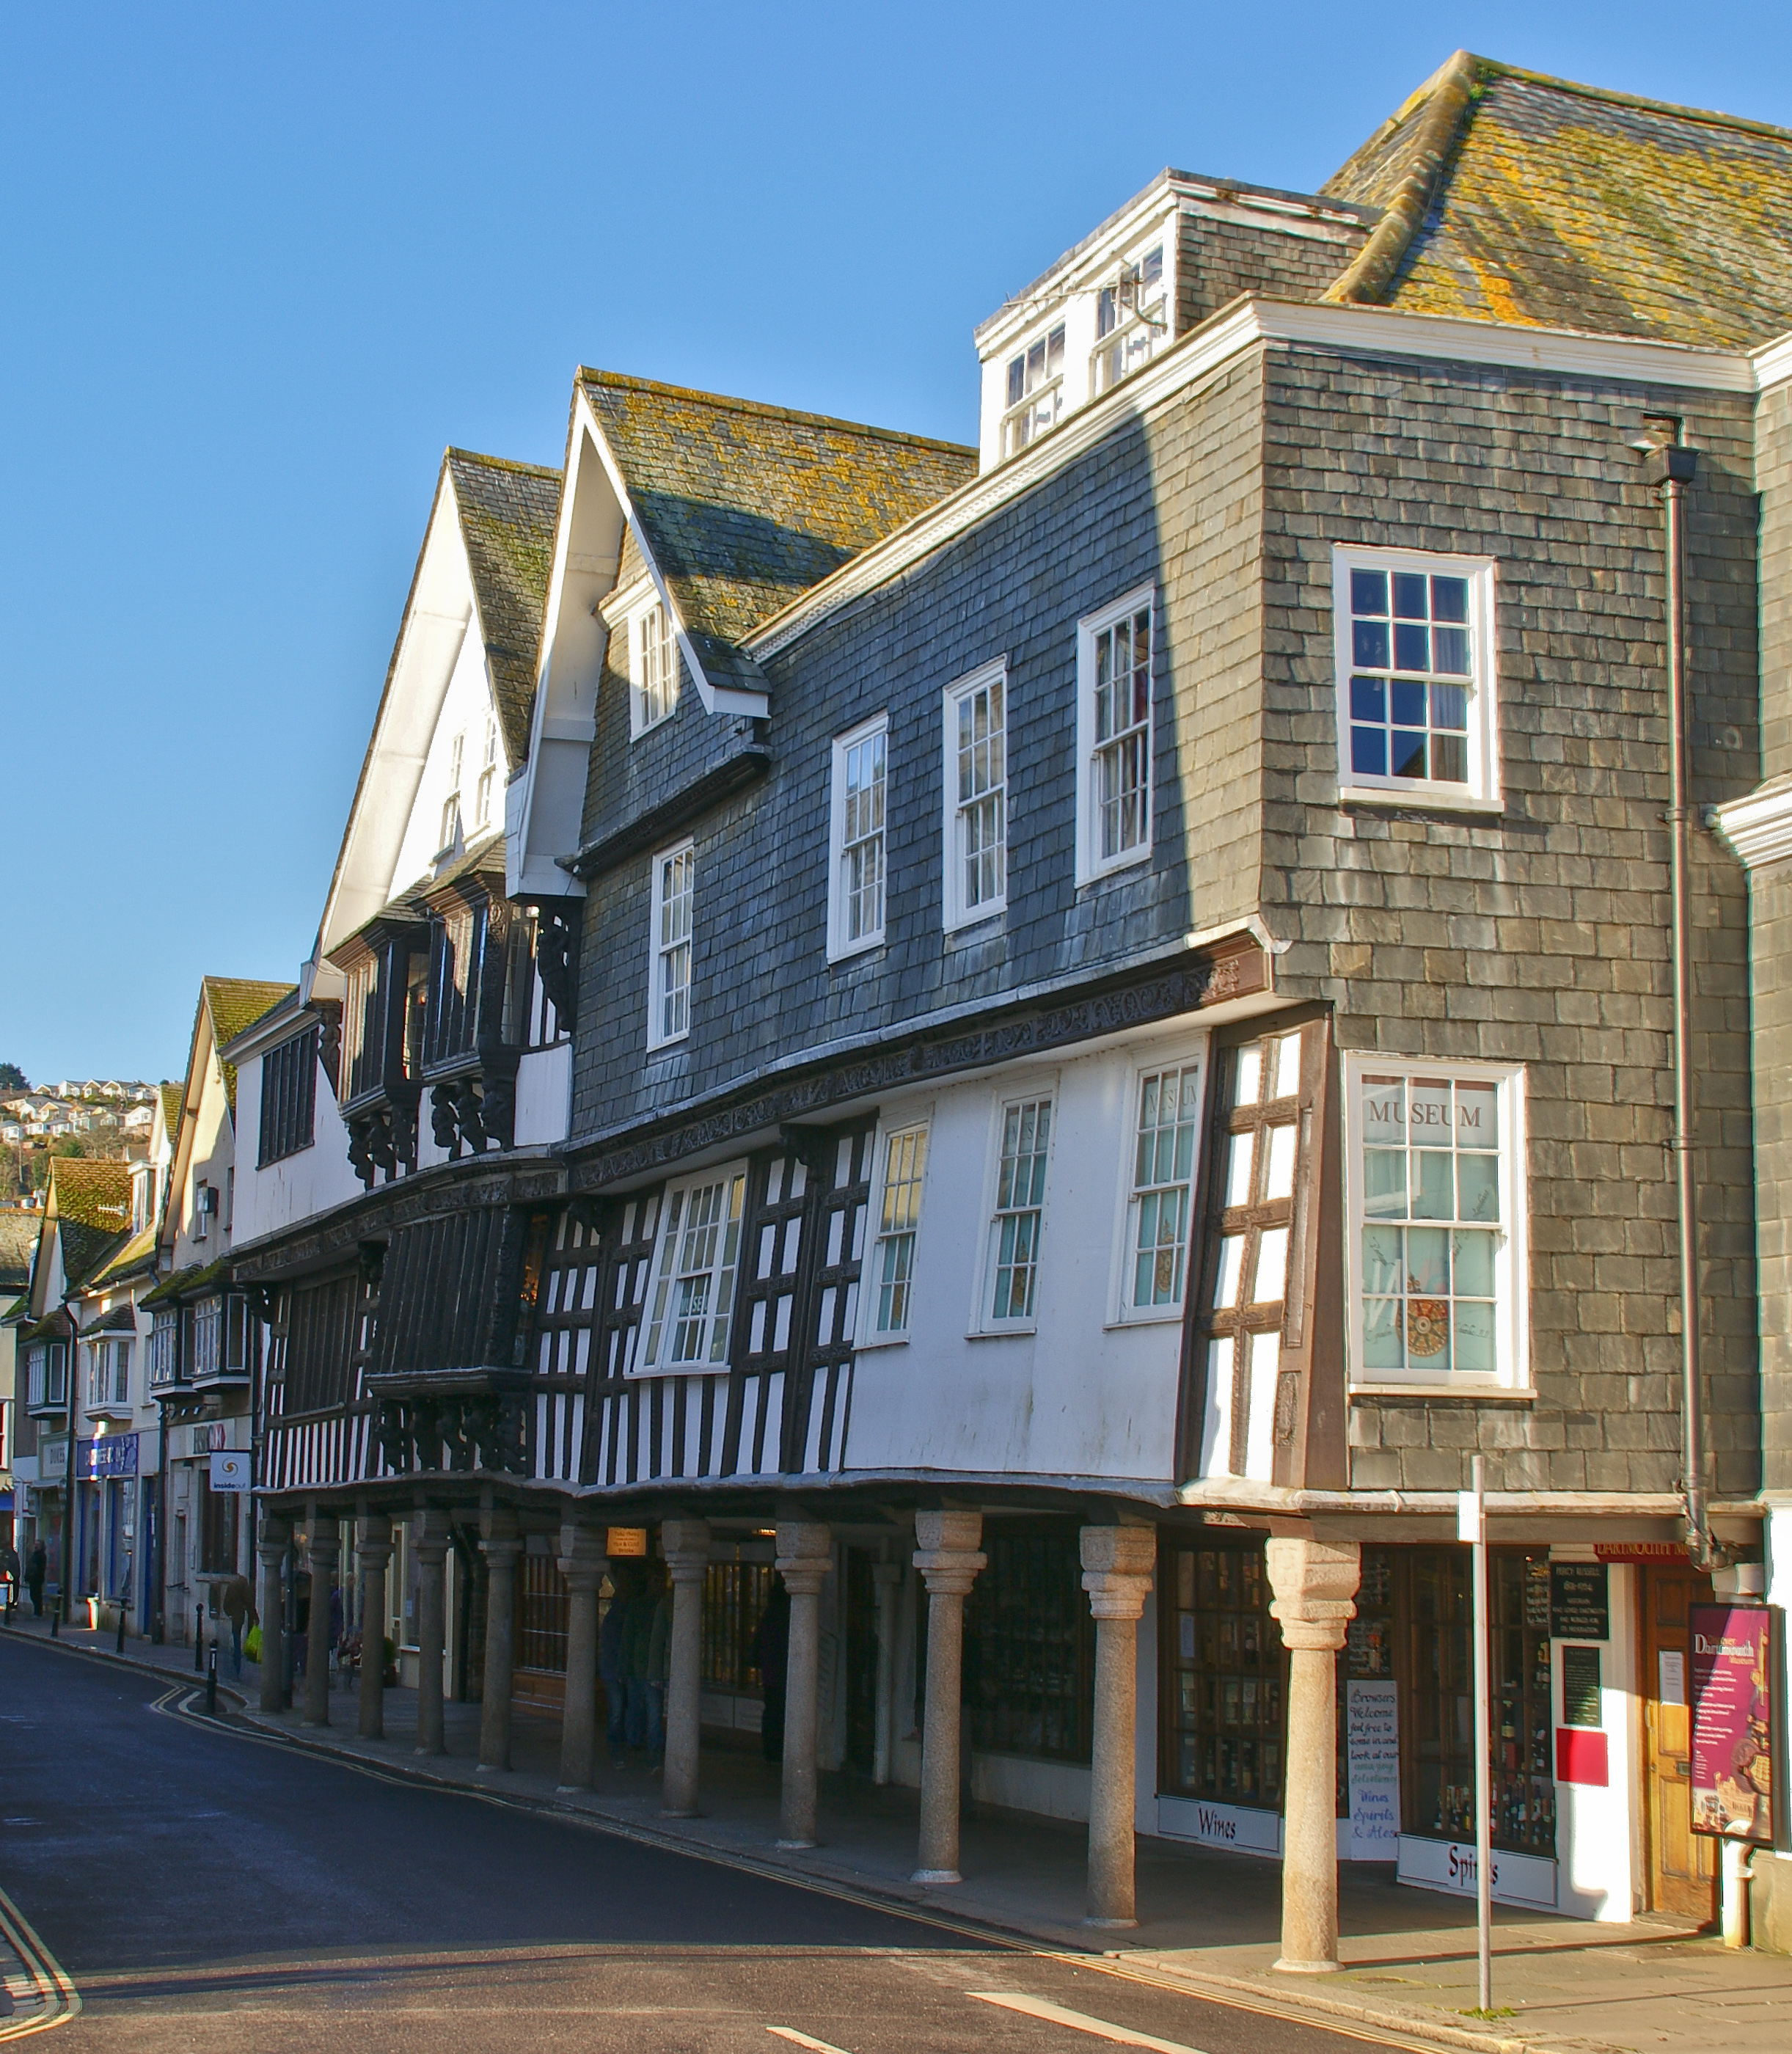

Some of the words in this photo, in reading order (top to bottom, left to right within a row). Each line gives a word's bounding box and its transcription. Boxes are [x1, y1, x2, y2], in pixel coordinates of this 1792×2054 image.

[1369, 1100, 1482, 1128] MUSEUM
[1597, 1543, 1670, 1556] DARTMOUTH
[1694, 1634, 1755, 1657] Dartmouth
[1197, 1806, 1236, 1840] Wines
[1447, 1844, 1499, 1887] Spirs
